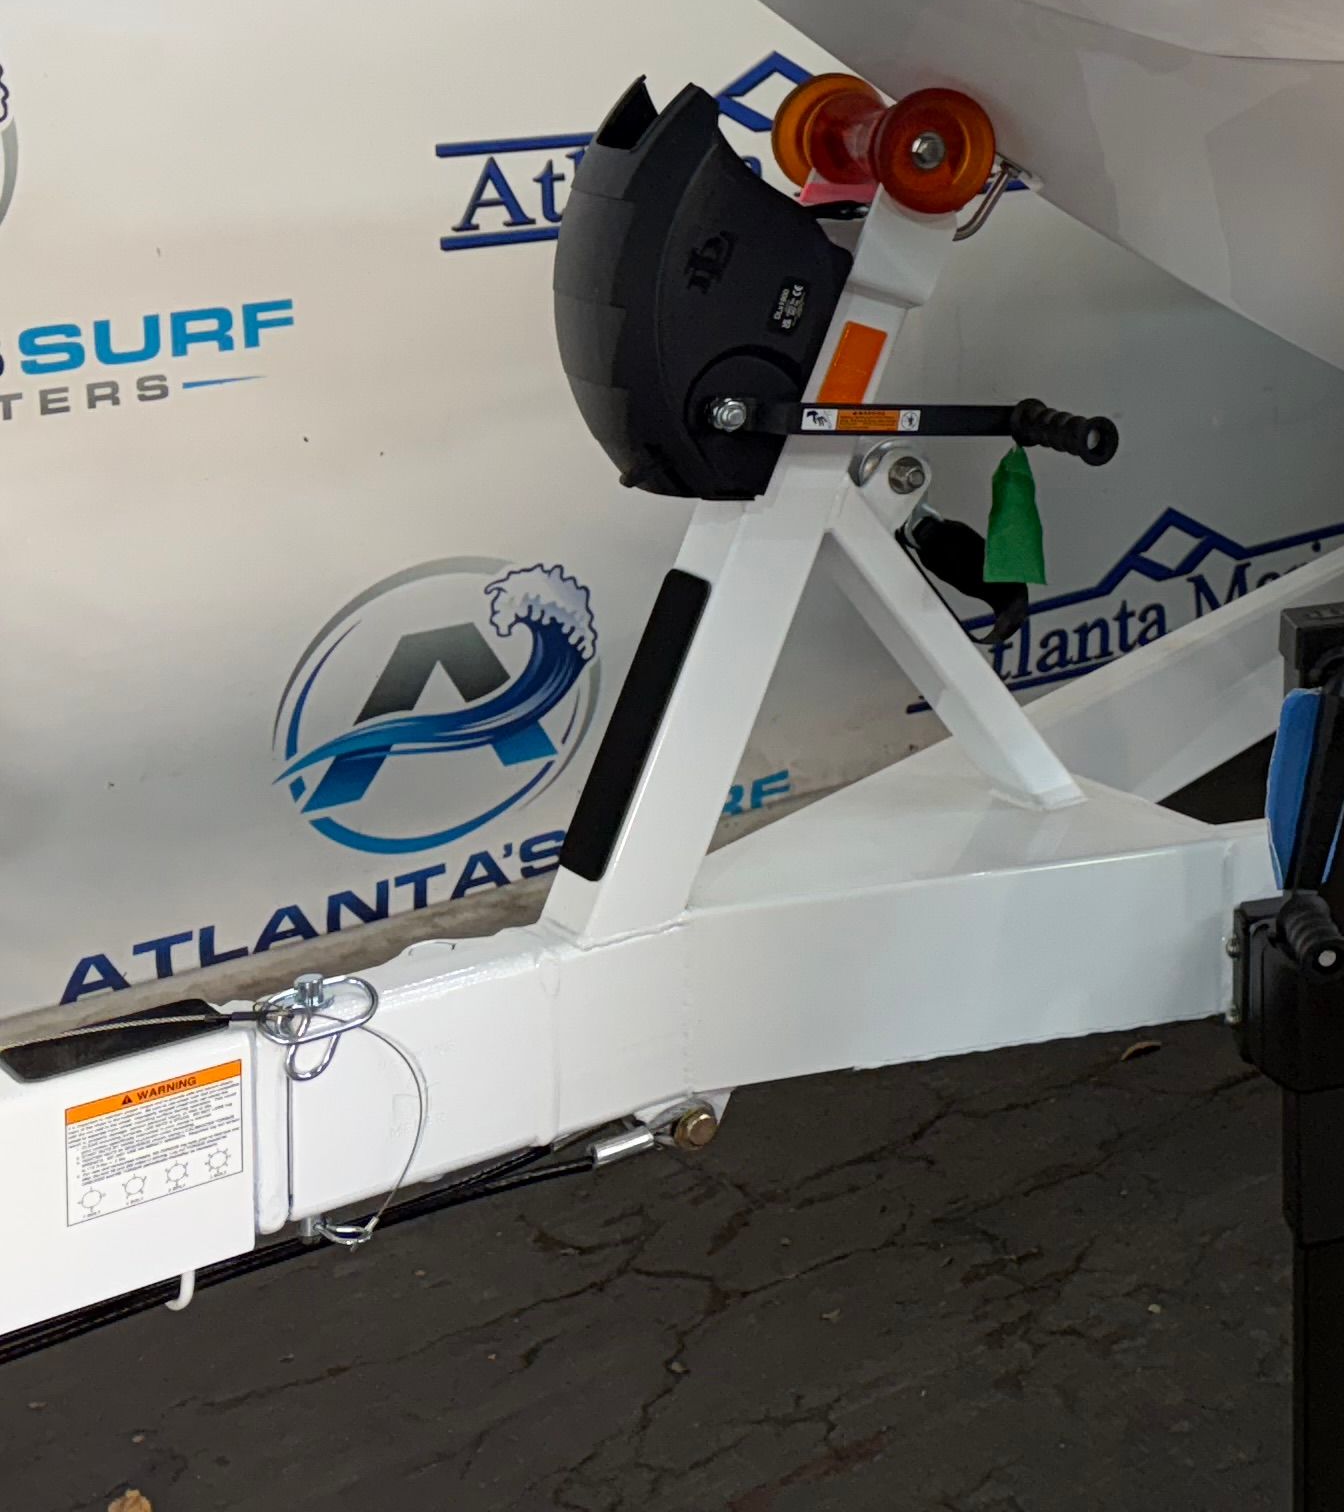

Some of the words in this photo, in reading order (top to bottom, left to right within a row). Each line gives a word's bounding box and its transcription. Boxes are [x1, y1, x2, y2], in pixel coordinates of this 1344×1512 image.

[18, 298, 295, 376] SURF
[987, 598, 1173, 682] tlanta
[136, 1076, 198, 1101] WARNING
